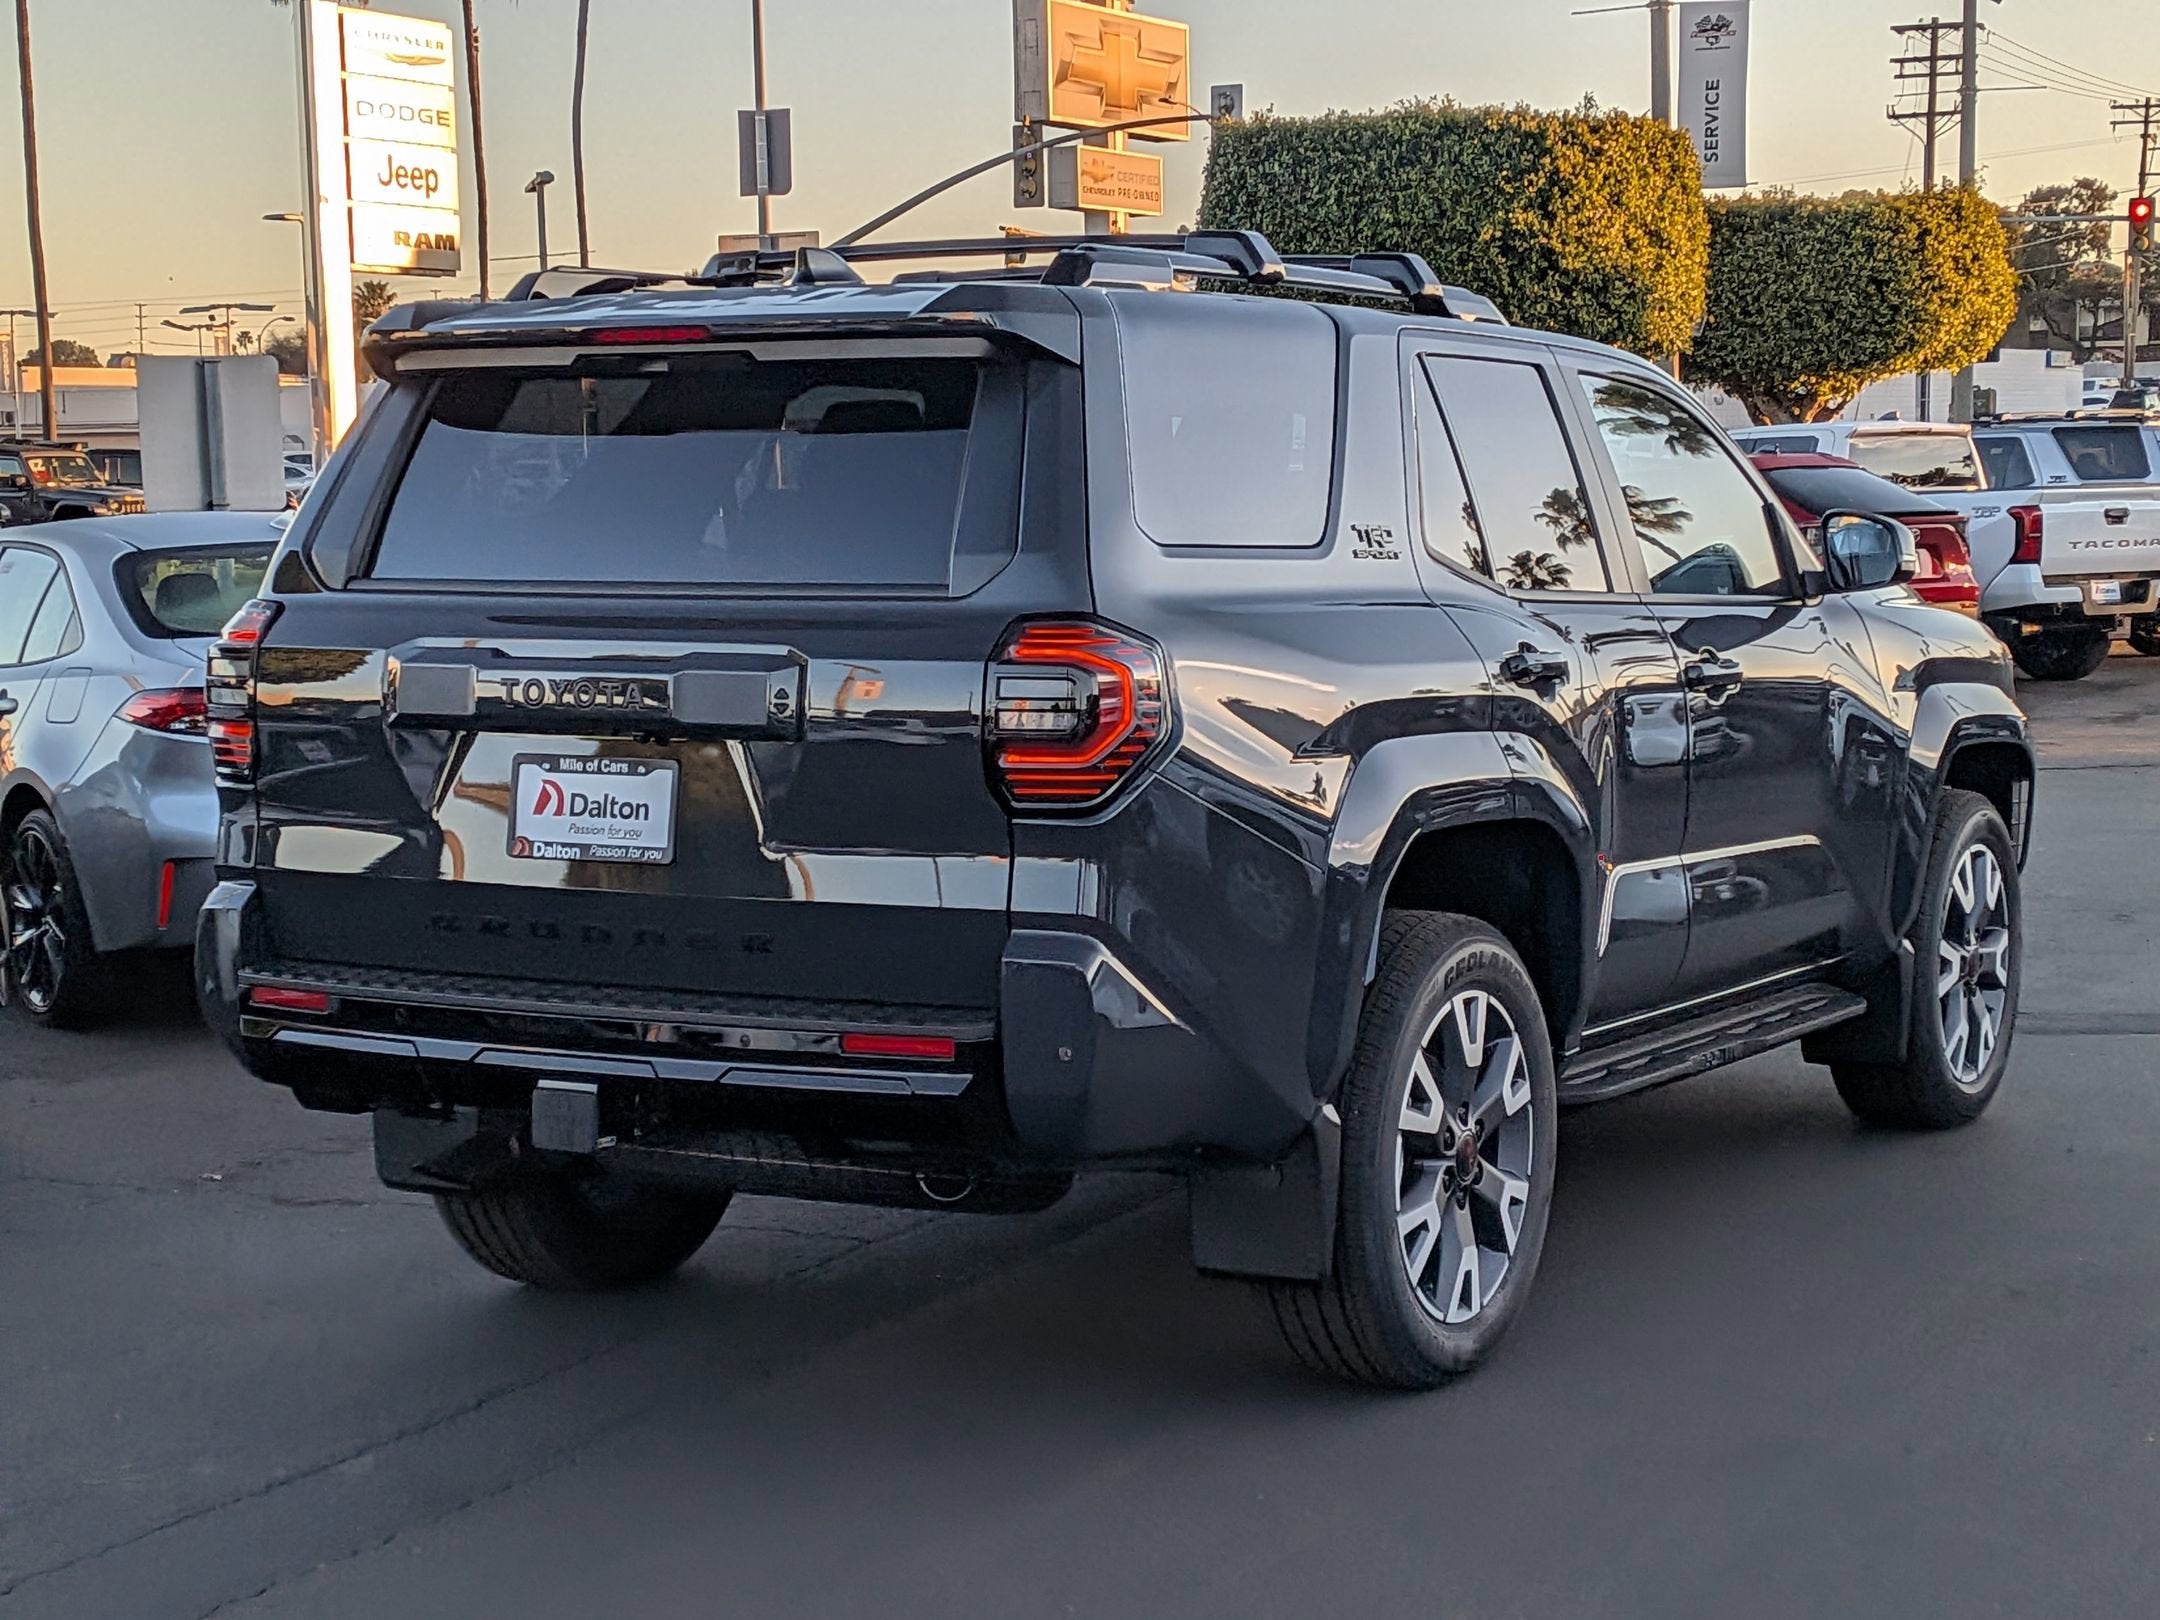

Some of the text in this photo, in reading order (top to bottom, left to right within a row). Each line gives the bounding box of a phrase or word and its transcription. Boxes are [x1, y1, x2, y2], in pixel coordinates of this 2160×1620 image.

[356, 100, 451, 127] DODGE
[1704, 79, 1720, 162] SERVICE
[377, 154, 439, 199] Jeep
[1117, 171, 1159, 186] CERTIFIED
[394, 230, 455, 250] RAM
[2069, 537, 2160, 550] TACOMA
[500, 677, 646, 713] TOYOTA
[559, 758, 629, 773] Mile of Cars
[569, 792, 650, 821] Dalton
[568, 822, 643, 839] Passion for you
[533, 841, 663, 861] Dalton Passion for you
